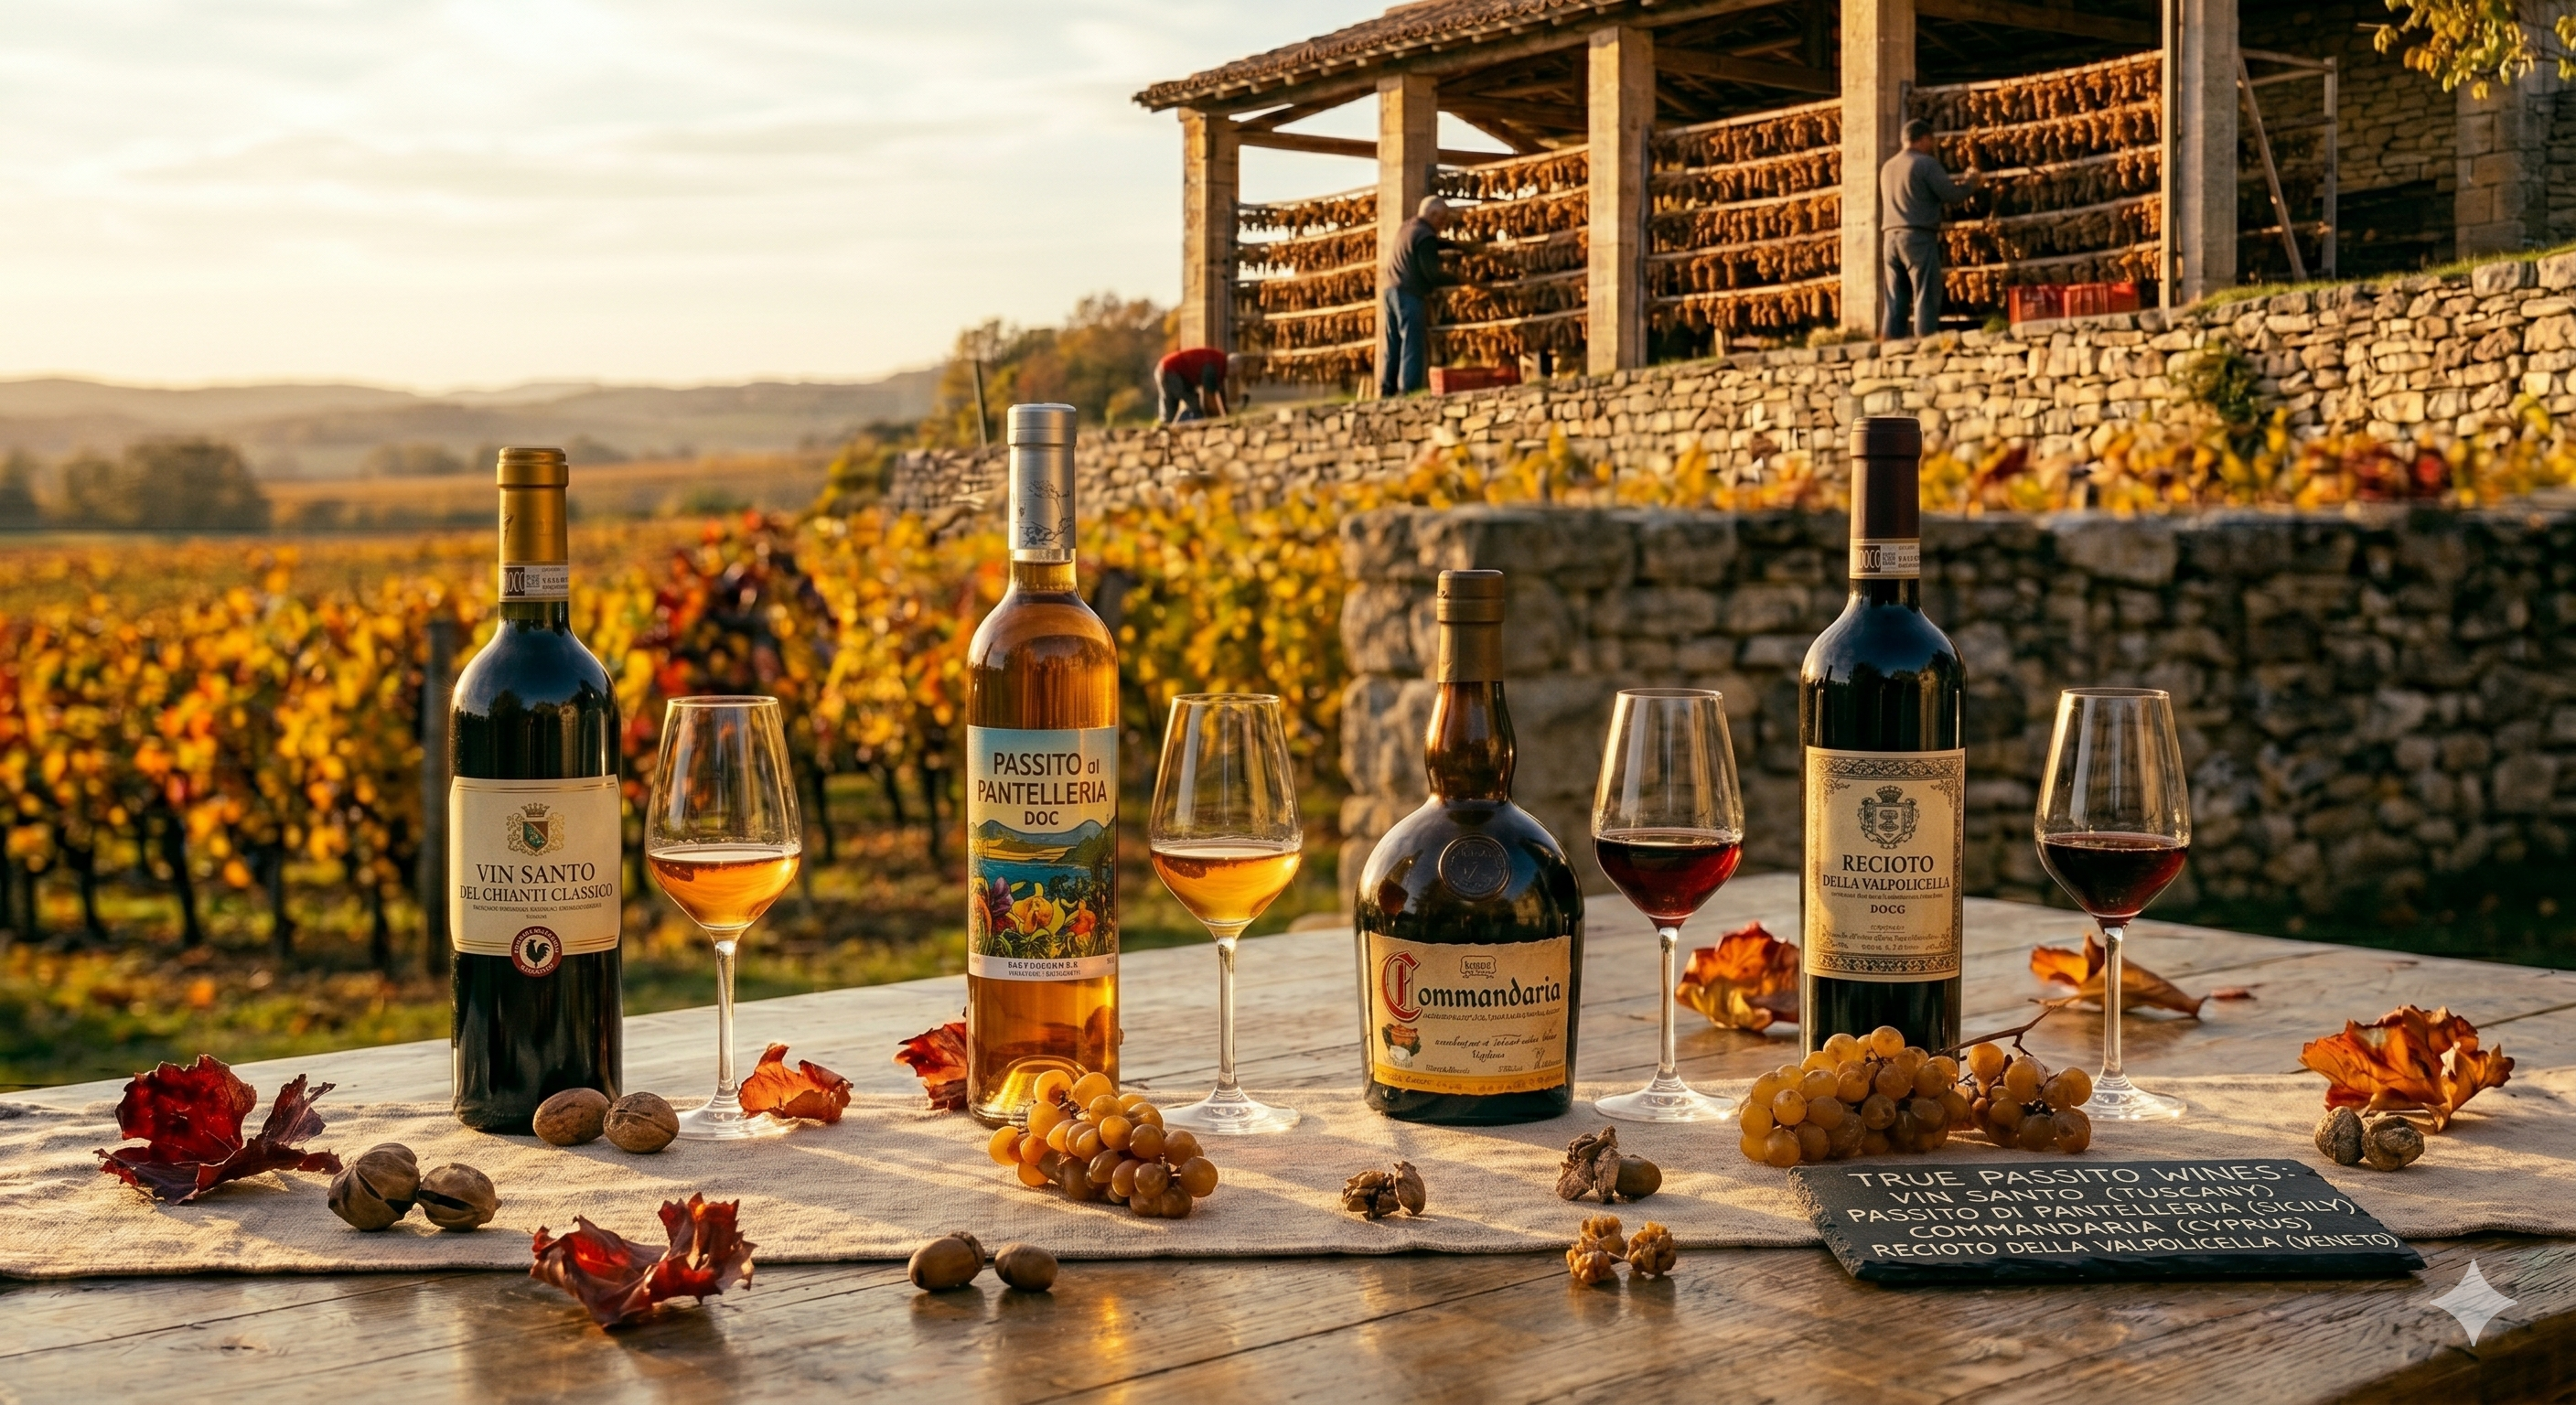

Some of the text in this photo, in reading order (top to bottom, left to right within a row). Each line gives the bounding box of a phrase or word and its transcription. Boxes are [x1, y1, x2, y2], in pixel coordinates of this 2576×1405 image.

[993, 752, 1082, 776] PASSITO
[978, 779, 1108, 805] PANTELLERIA
[1025, 810, 1059, 826] DOC
[476, 862, 596, 885] VIN SANTO
[1841, 854, 1935, 874] RECIOTO
[459, 883, 613, 902] DEL CHIANTI CLASSICO
[1822, 874, 1950, 891] DELLA VALPOLICELLA
[1870, 904, 1905, 914] DOCG
[1379, 949, 1562, 1024] Commandaria
[1847, 1165, 2296, 1187] TRUE PASSITO WINES:
[1889, 1184, 2274, 1205] VIN SANTO (TUSCANY)
[1846, 1198, 2356, 1223] PASSITO DI PANTELLERIA (SICILY)
[1909, 1217, 2313, 1239] COMMANDARIA (CYPRUS)
[1871, 1232, 2399, 1258] RECIOTO DELLA VALPOLICELLA (VENETO)
